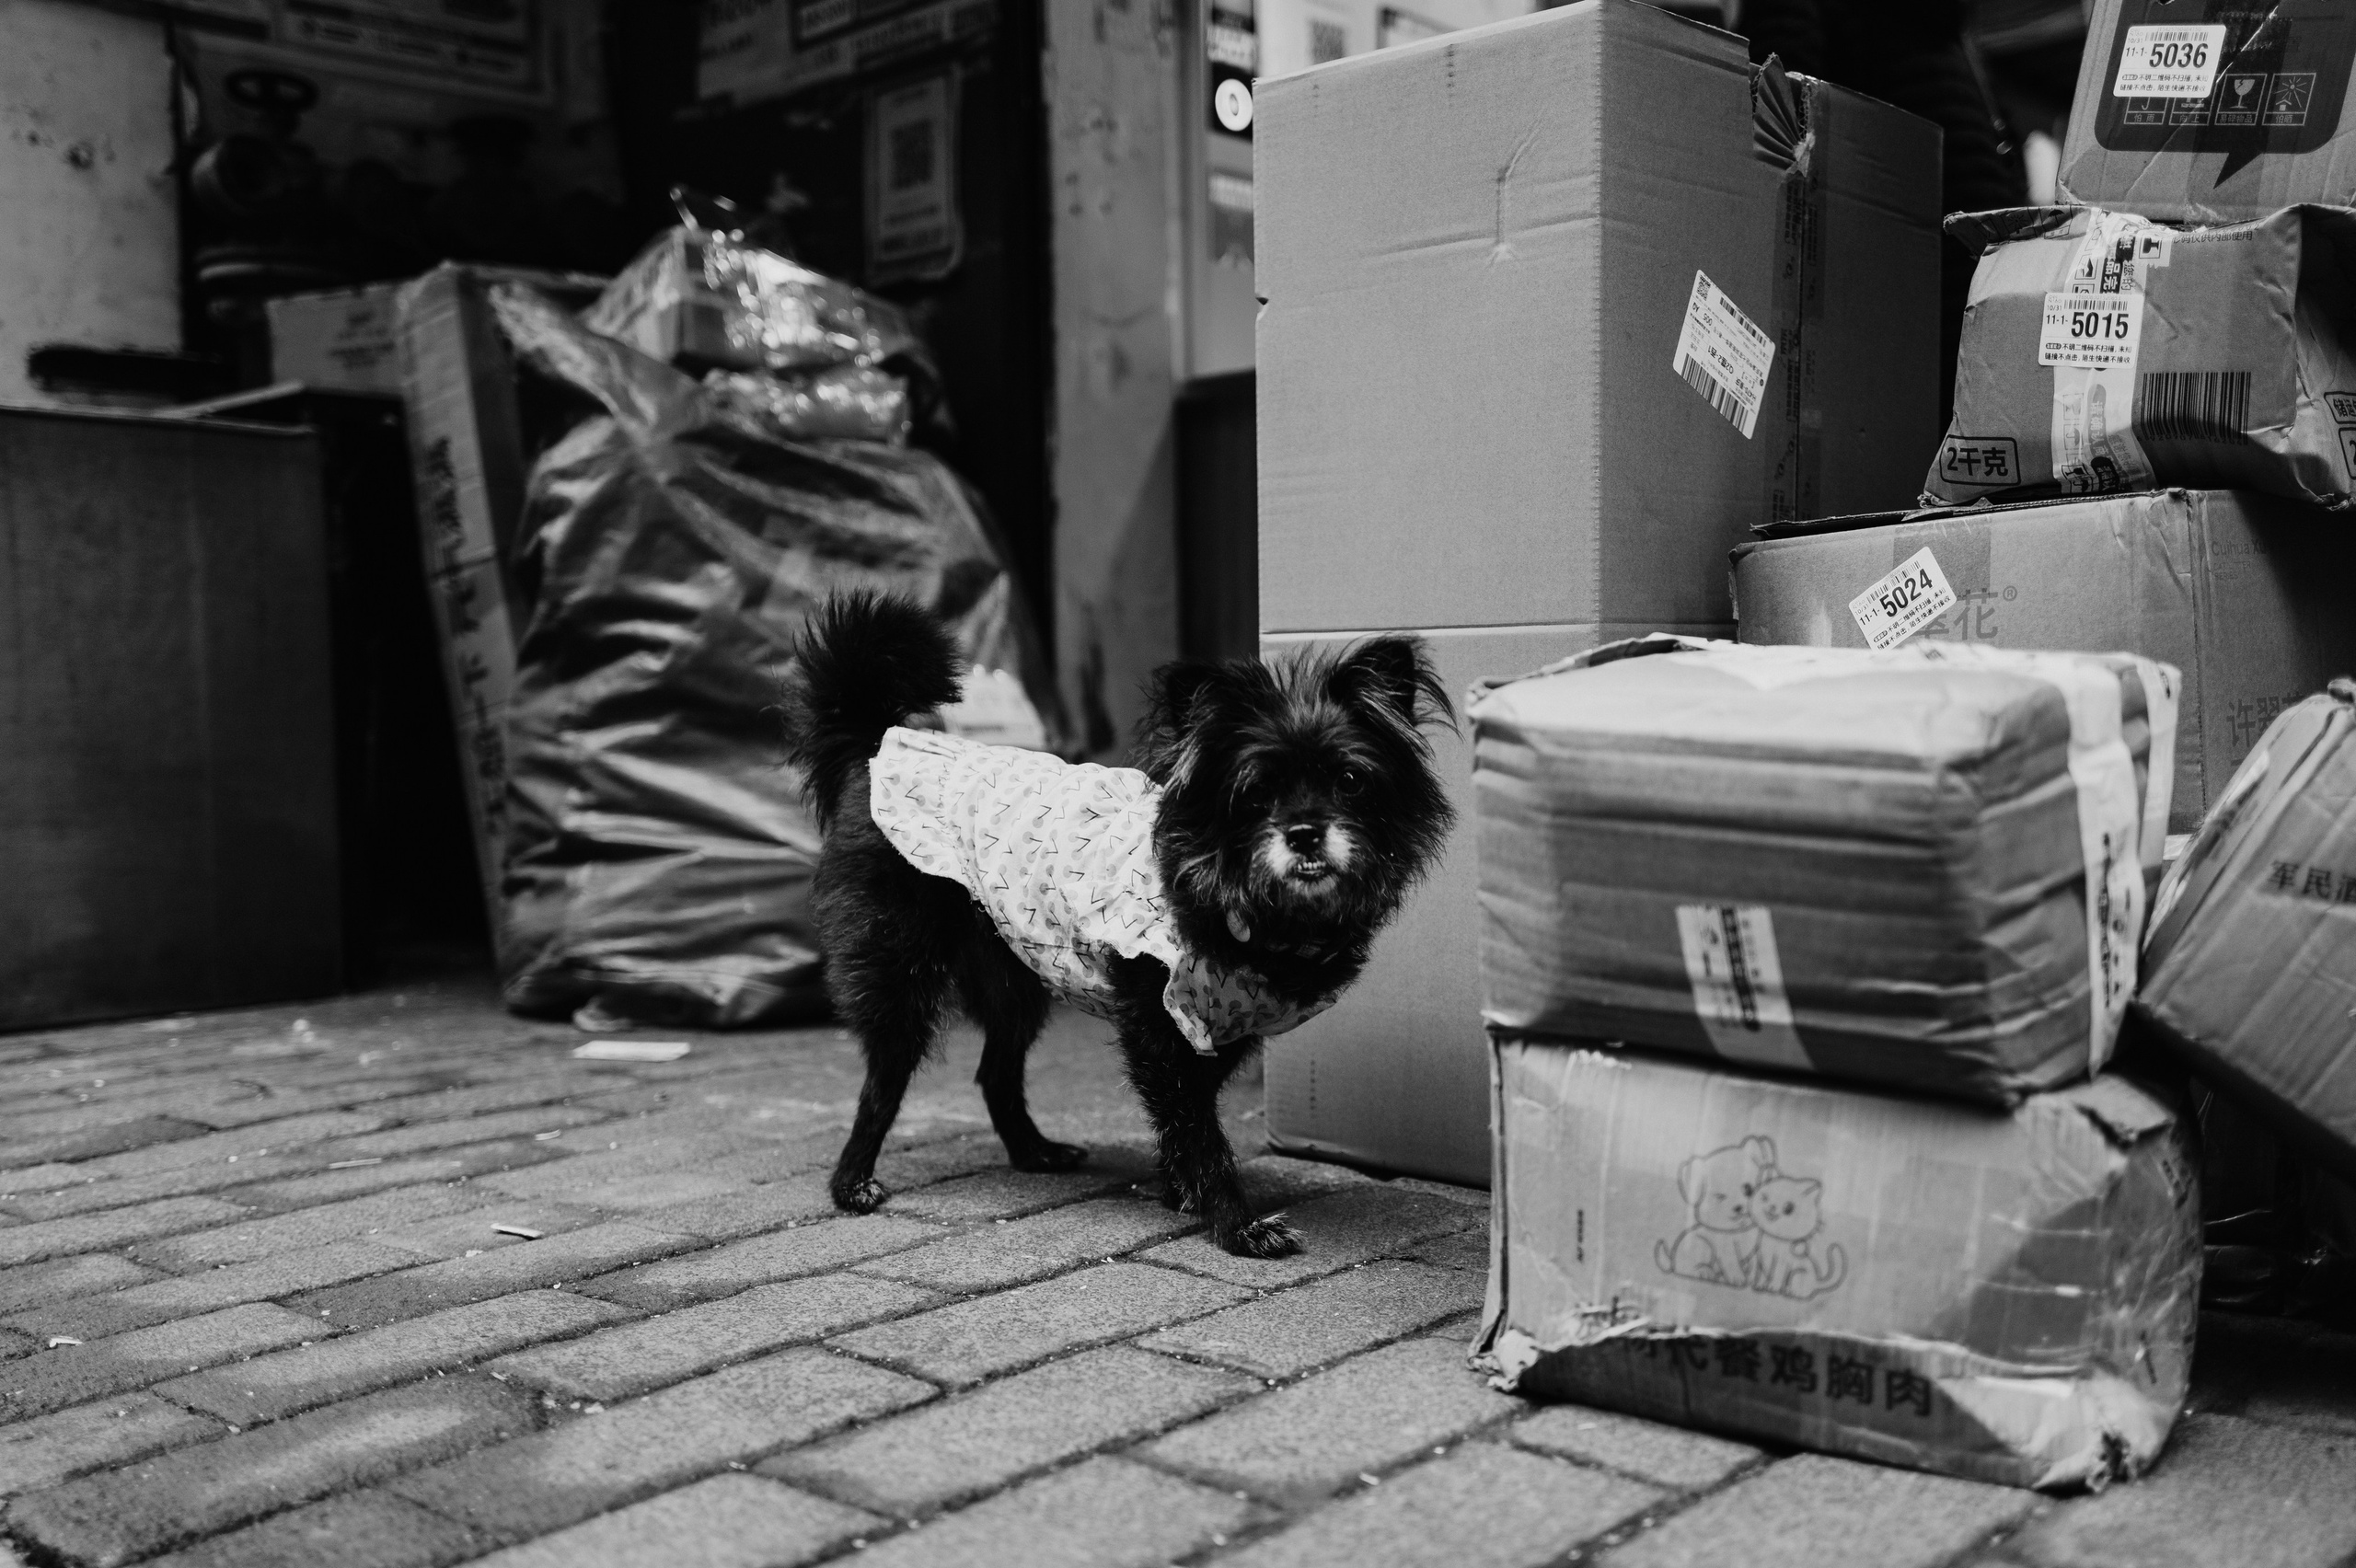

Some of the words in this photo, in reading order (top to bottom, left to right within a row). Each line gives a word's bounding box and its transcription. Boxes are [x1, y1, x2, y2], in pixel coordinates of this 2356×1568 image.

[2332, 398, 2356, 417] 储运
[1946, 447, 2008, 476] 2千克
[1627, 1336, 1933, 1418] 代餐鸡胸肉
